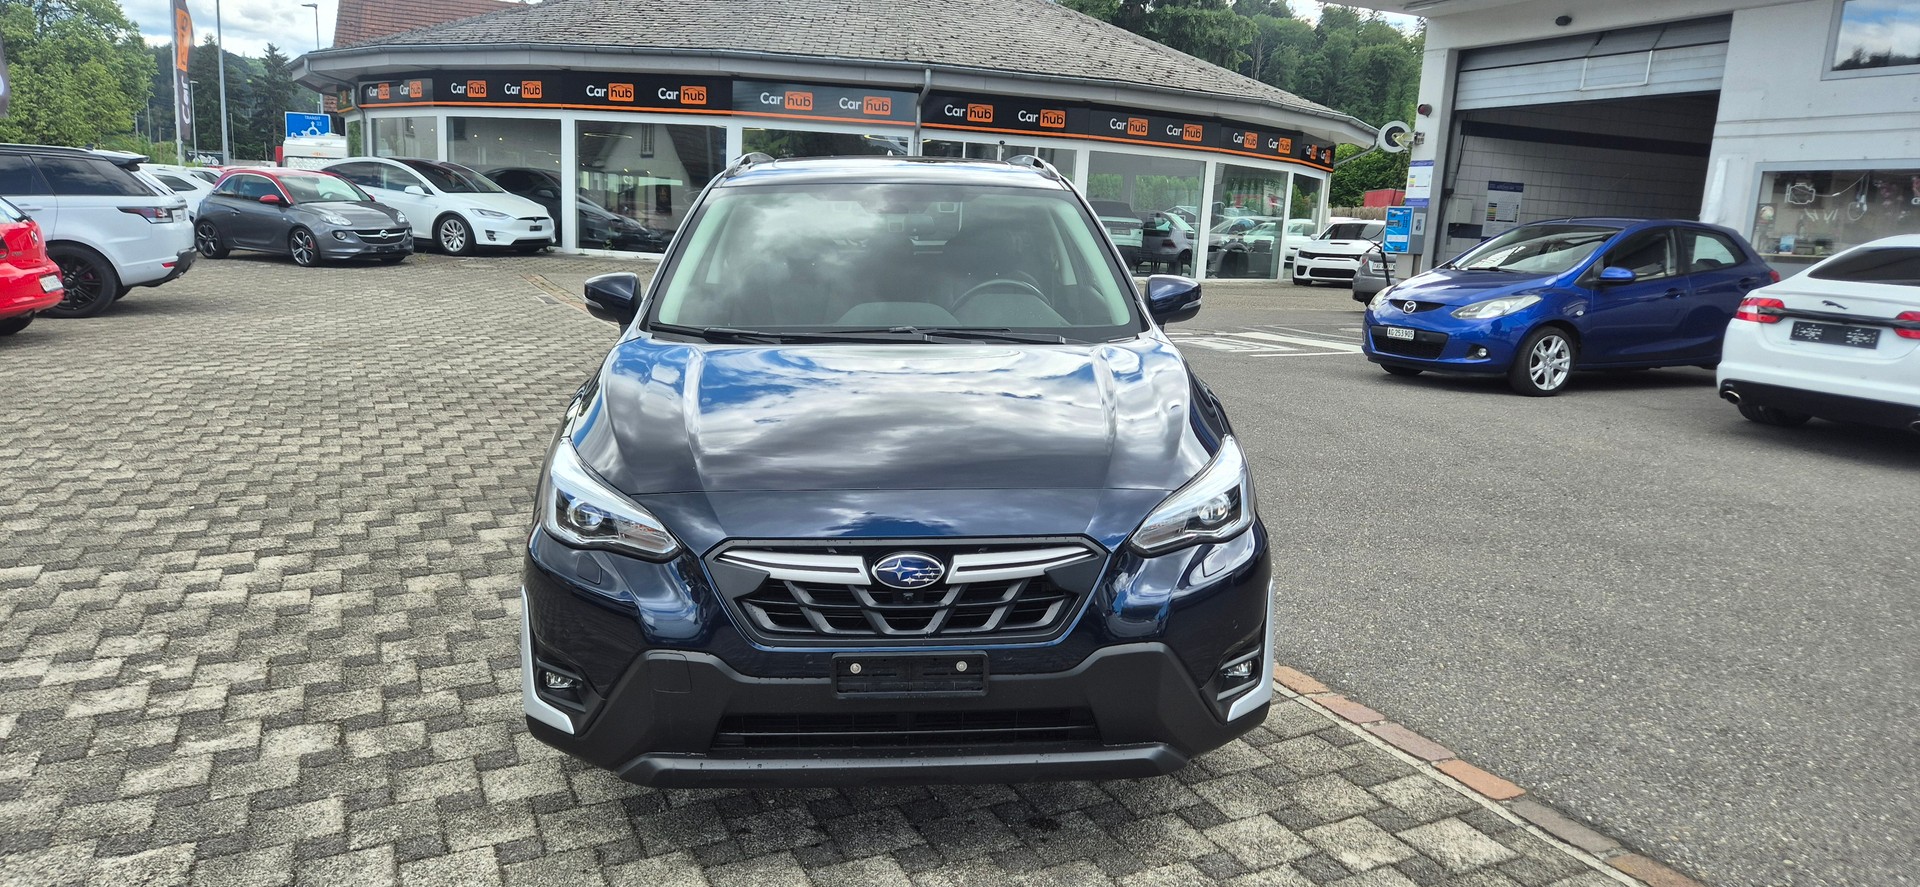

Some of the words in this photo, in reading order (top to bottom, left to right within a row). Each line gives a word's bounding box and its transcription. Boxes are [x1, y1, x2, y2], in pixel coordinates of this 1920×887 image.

[369, 87, 377, 96] Car
[400, 85, 409, 95] Car
[451, 83, 466, 94] Car
[469, 84, 485, 95] hub
[504, 84, 520, 94] Car
[524, 84, 540, 95] hub
[586, 85, 607, 97] Car
[611, 85, 632, 99] hub
[658, 88, 679, 100] Car
[683, 89, 705, 101] hub
[760, 92, 783, 105] Car
[788, 94, 811, 107] hub
[839, 98, 861, 110] Car
[866, 99, 889, 113] hub
[944, 105, 966, 116] Car
[970, 106, 992, 119] hub
[1018, 111, 1038, 122] Car
[1042, 112, 1064, 125] hub
[1110, 118, 1126, 130] Car
[1130, 120, 1146, 133] hub
[1167, 125, 1182, 136] Car
[1185, 126, 1201, 139] hub
[1233, 133, 1244, 144] Car
